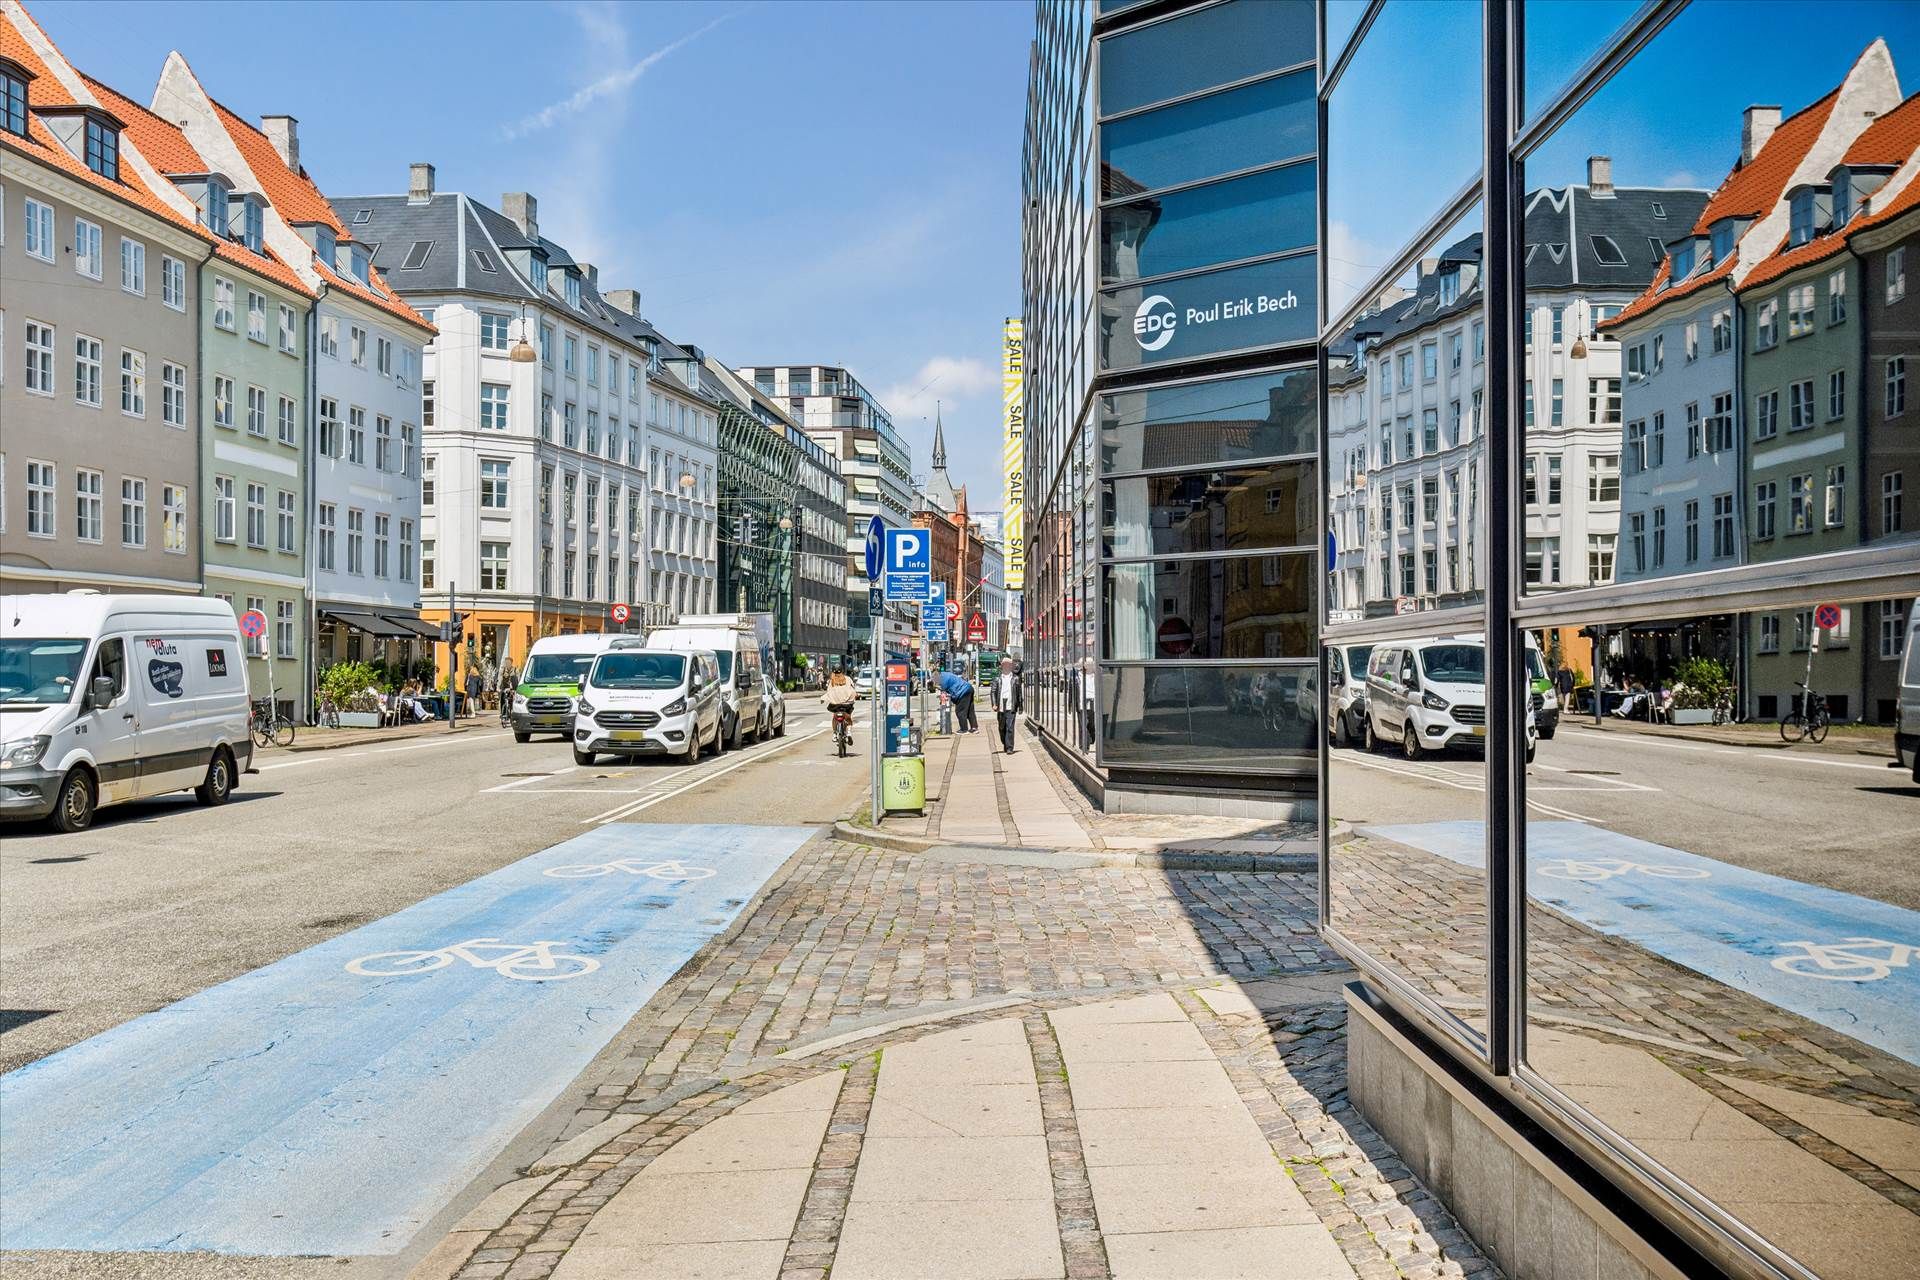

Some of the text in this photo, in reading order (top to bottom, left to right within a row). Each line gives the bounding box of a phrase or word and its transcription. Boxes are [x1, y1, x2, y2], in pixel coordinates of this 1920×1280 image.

[1133, 290, 1297, 335] EDC Poul Erik Bech
[1009, 339, 1023, 571] SALE SALE SALE SALE
[896, 534, 920, 568] P
[145, 638, 164, 649] nem
